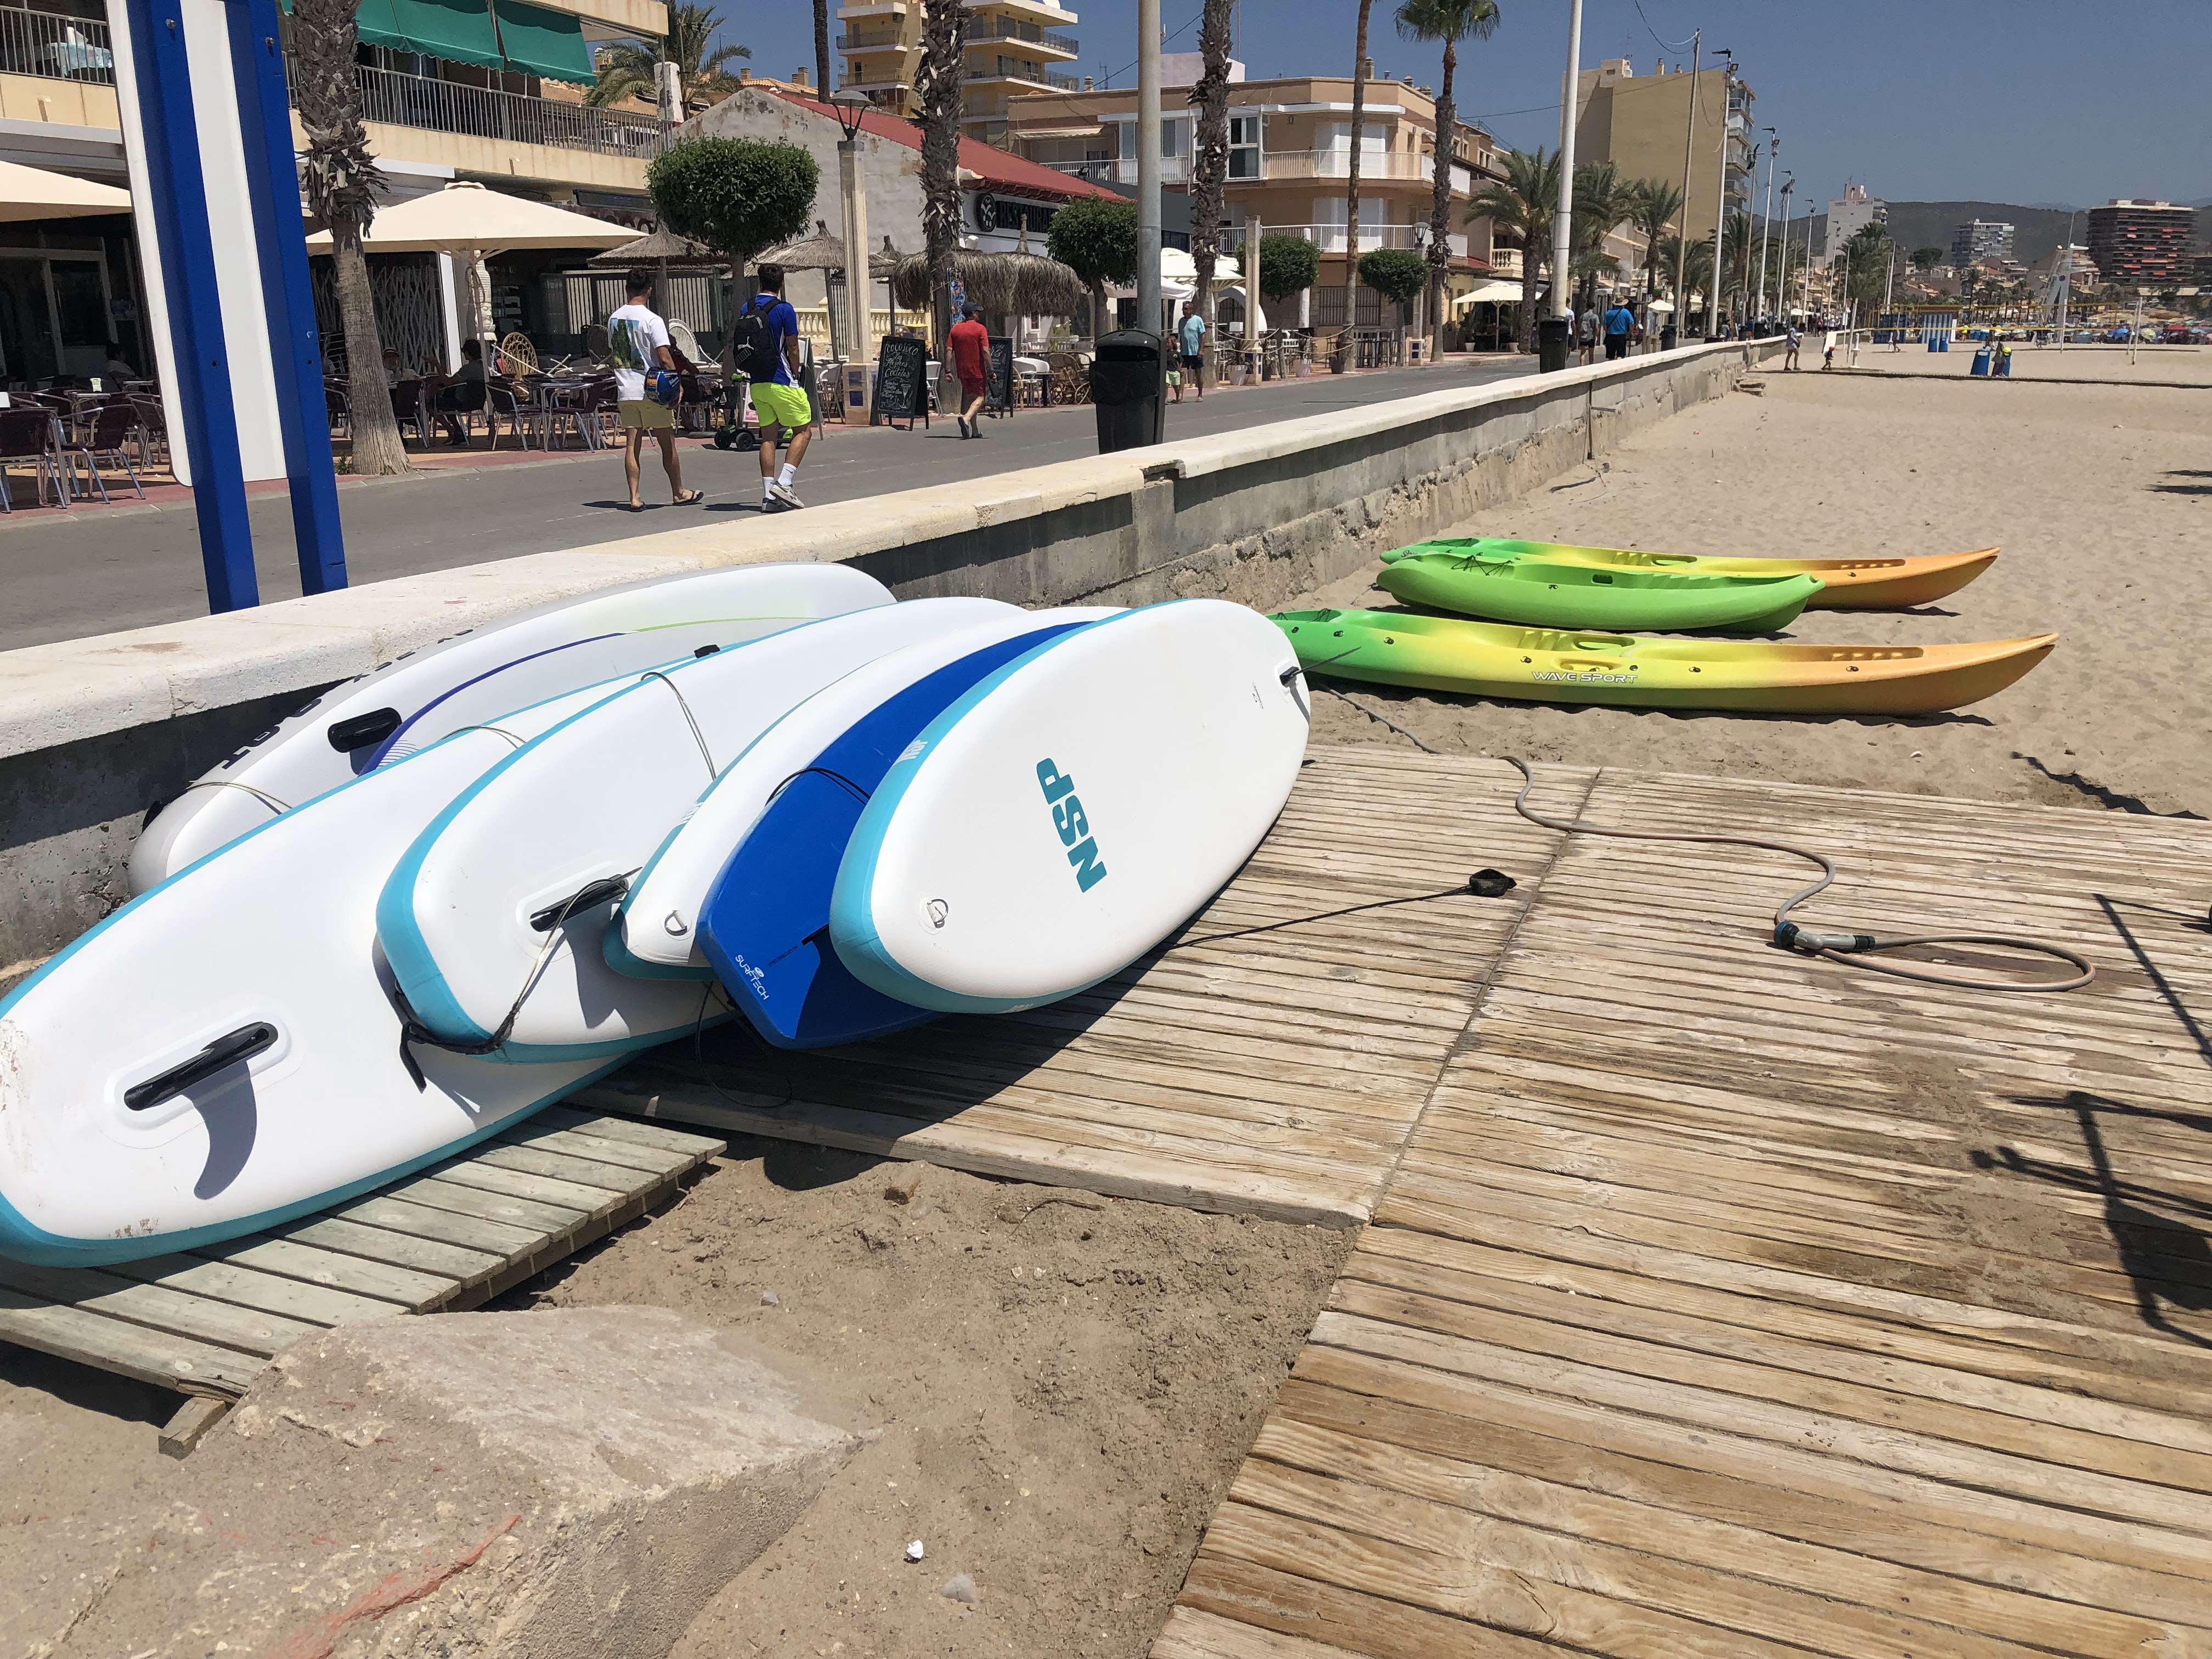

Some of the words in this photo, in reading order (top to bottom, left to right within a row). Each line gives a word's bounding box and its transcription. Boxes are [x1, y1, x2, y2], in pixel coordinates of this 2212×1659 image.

[1531, 672, 1577, 681] WAVE
[1579, 673, 1637, 684] SPORT
[1036, 758, 1107, 893] NSP
[735, 955, 769, 1000] SURFTECH
